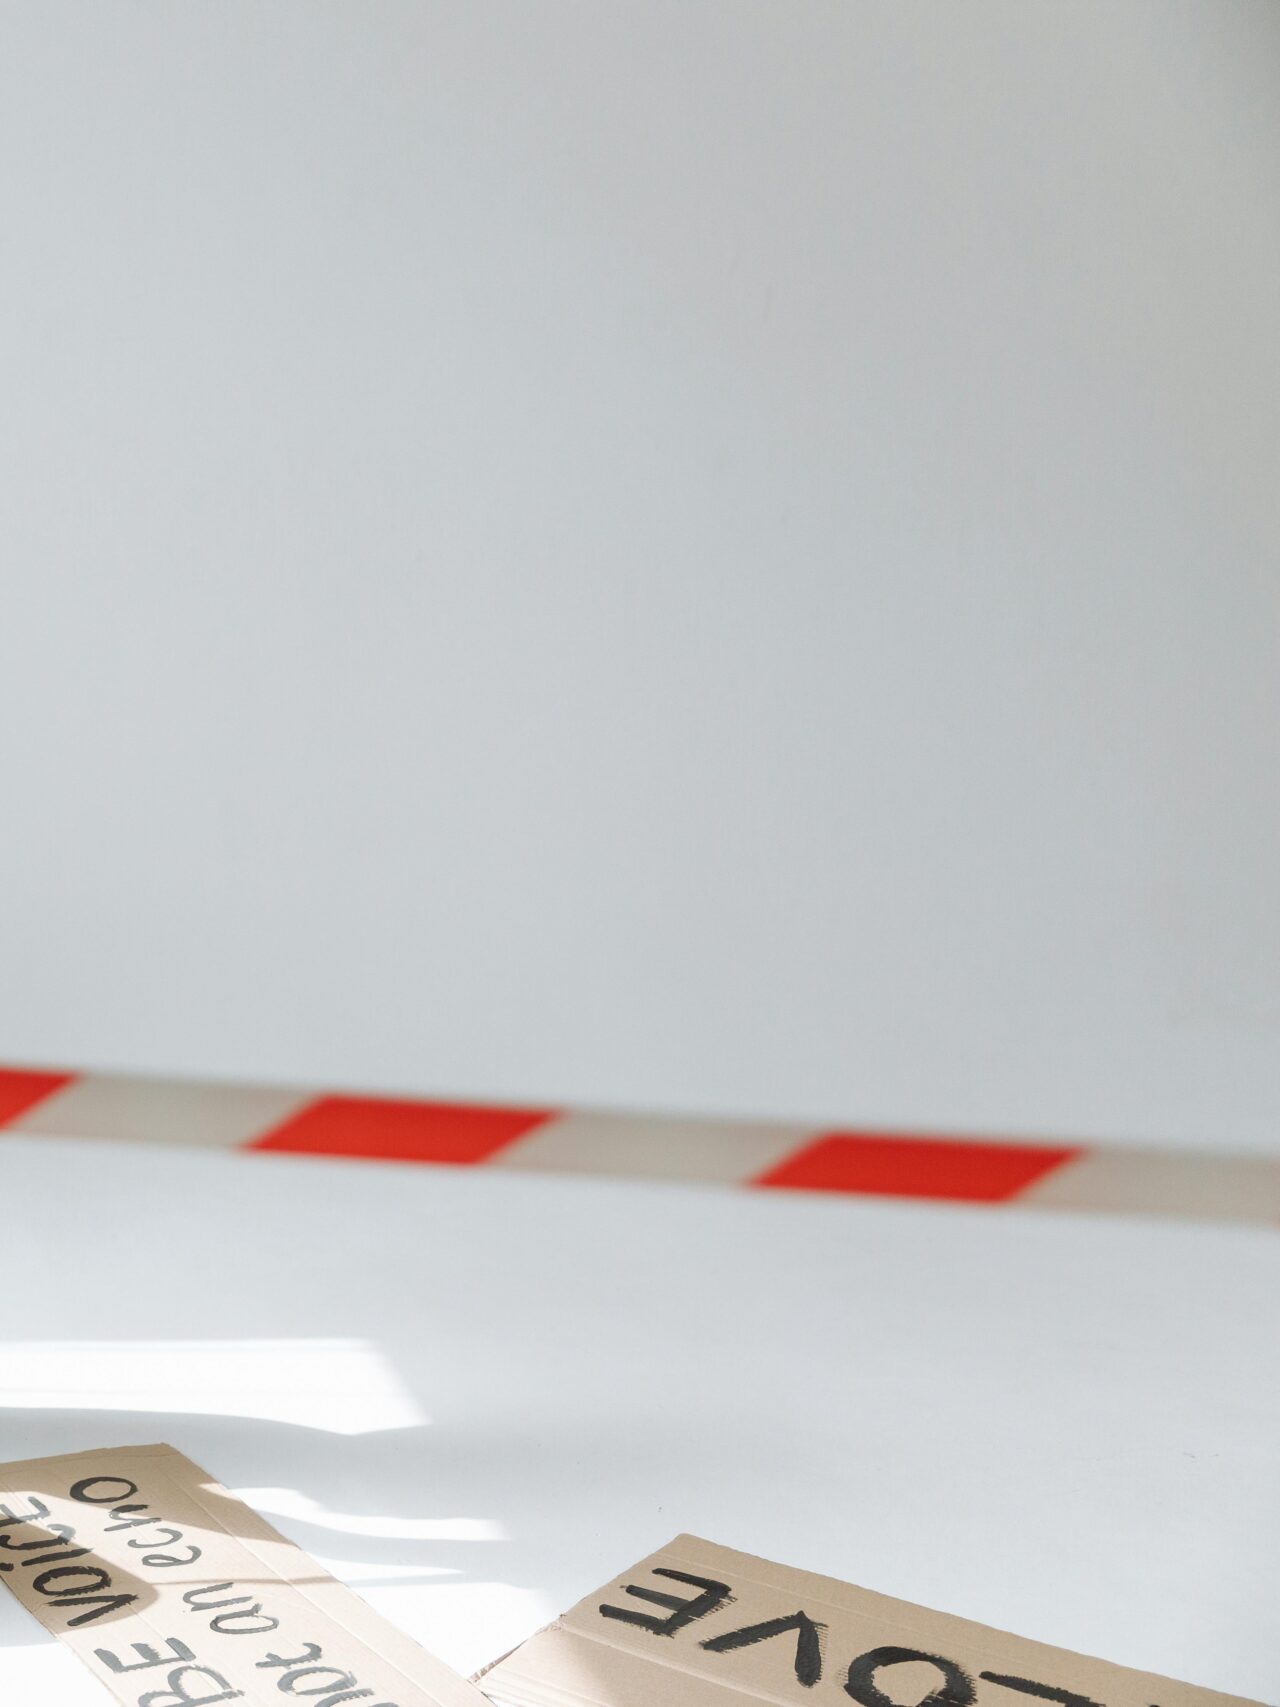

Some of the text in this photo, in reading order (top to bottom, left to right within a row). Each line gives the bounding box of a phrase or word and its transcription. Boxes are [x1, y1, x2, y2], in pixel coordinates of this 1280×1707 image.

[69, 1475, 202, 1568] echo
[182, 1582, 280, 1635] an
[94, 1637, 246, 1707] BE
